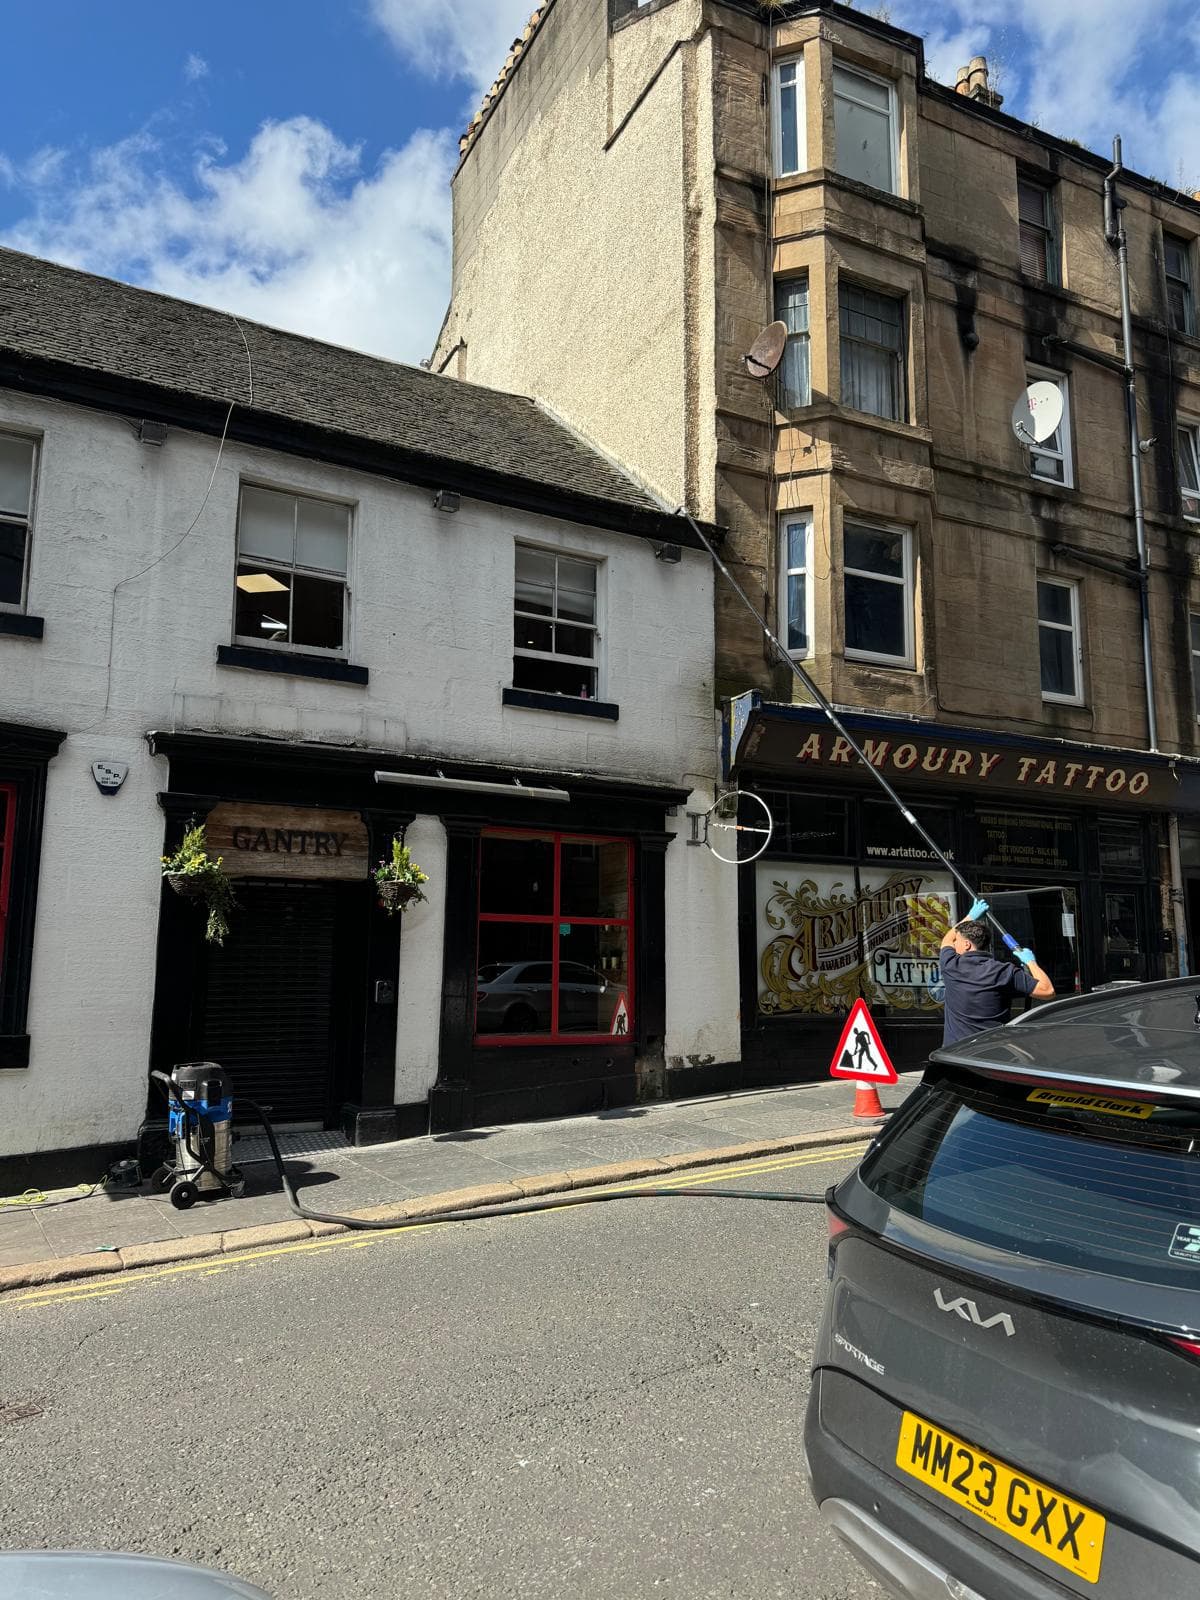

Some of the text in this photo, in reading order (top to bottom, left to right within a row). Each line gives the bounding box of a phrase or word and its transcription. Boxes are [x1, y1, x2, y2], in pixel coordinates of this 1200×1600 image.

[796, 733, 1150, 795] ARMOURY TATTOO
[233, 825, 347, 857] GANTRY
[866, 845, 954, 860] www.artattoo.cuk
[873, 947, 942, 984] TATTO
[1036, 1092, 1144, 1114] Arnold Clark
[933, 1288, 1016, 1336] KIA
[834, 1333, 885, 1375] SPORTAGE
[911, 1423, 1086, 1561] MM23 GXX
